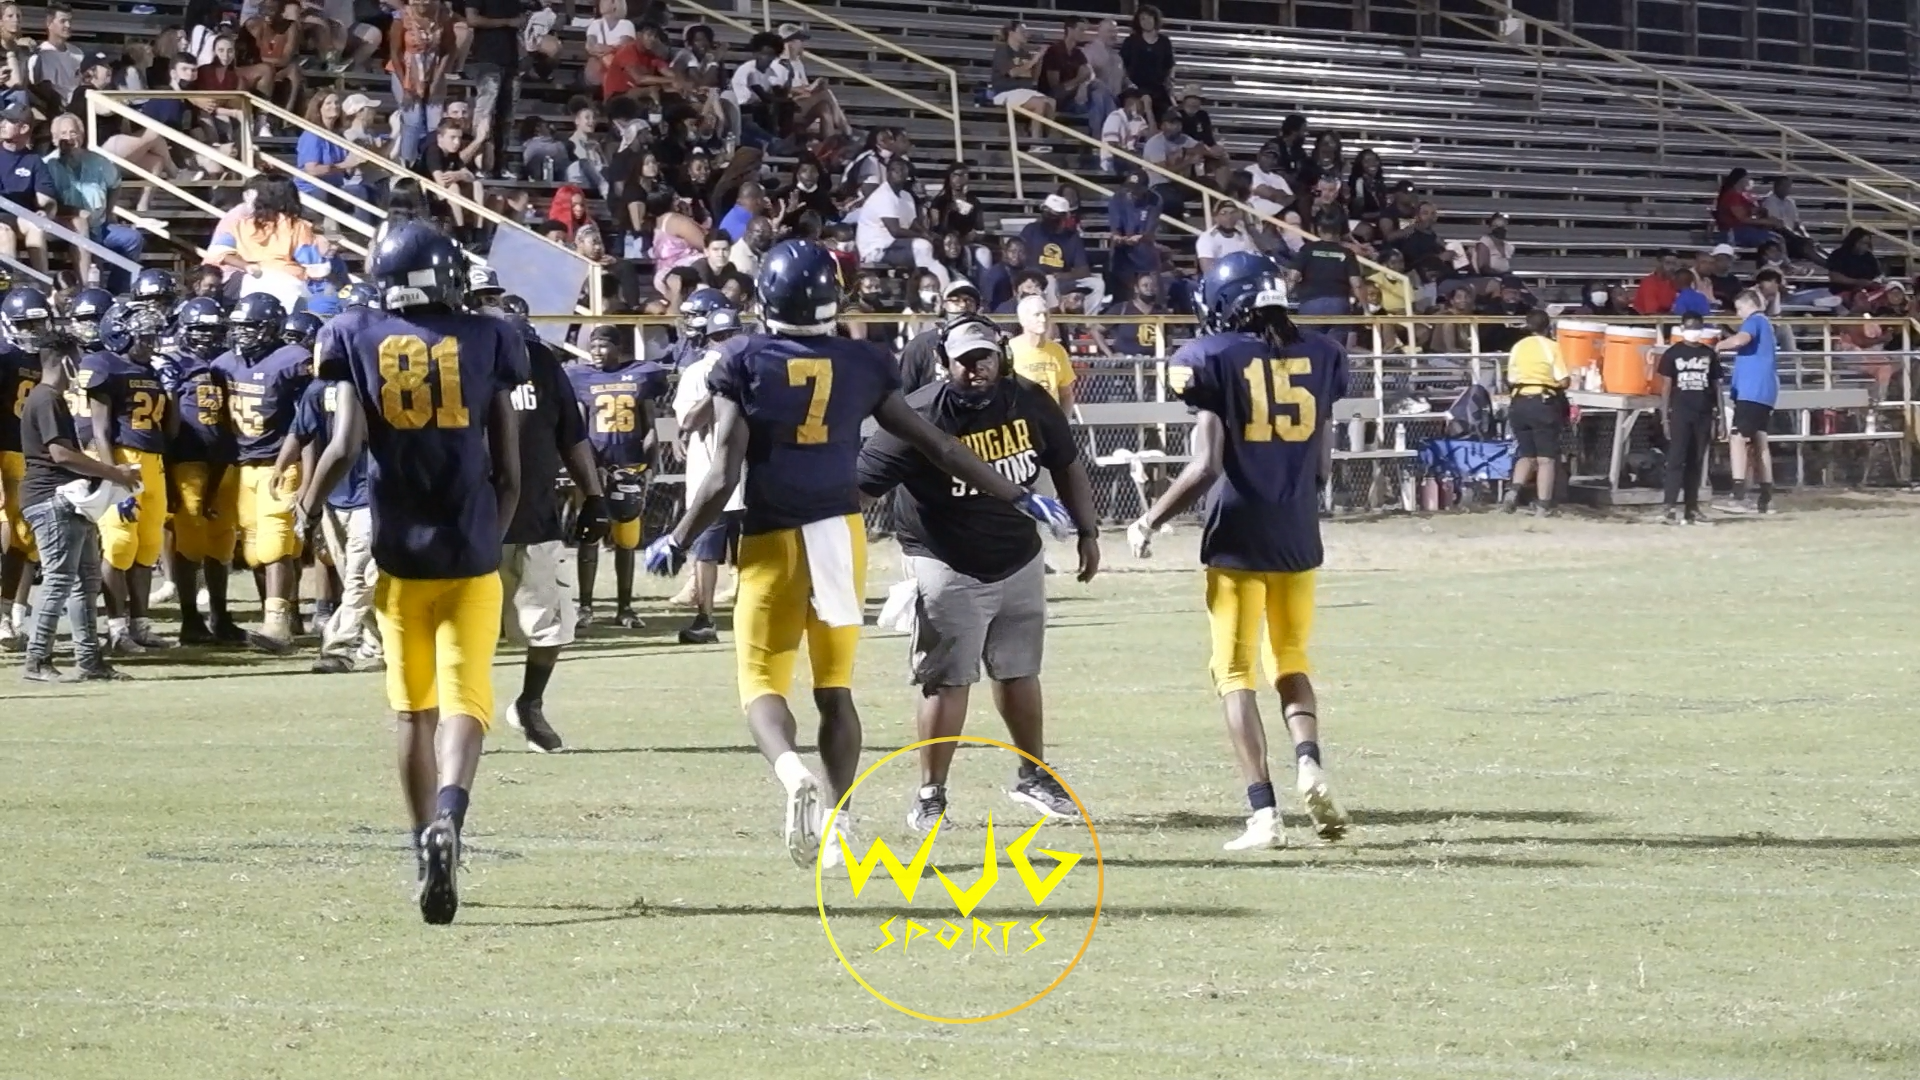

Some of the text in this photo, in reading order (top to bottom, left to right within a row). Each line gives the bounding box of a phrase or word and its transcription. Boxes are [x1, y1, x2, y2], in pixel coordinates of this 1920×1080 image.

[131, 391, 166, 431] 24
[378, 334, 470, 430] 81
[594, 394, 635, 433] 26
[786, 358, 833, 444] 7
[1243, 356, 1317, 442] 15
[959, 418, 1033, 463] OUGAR
